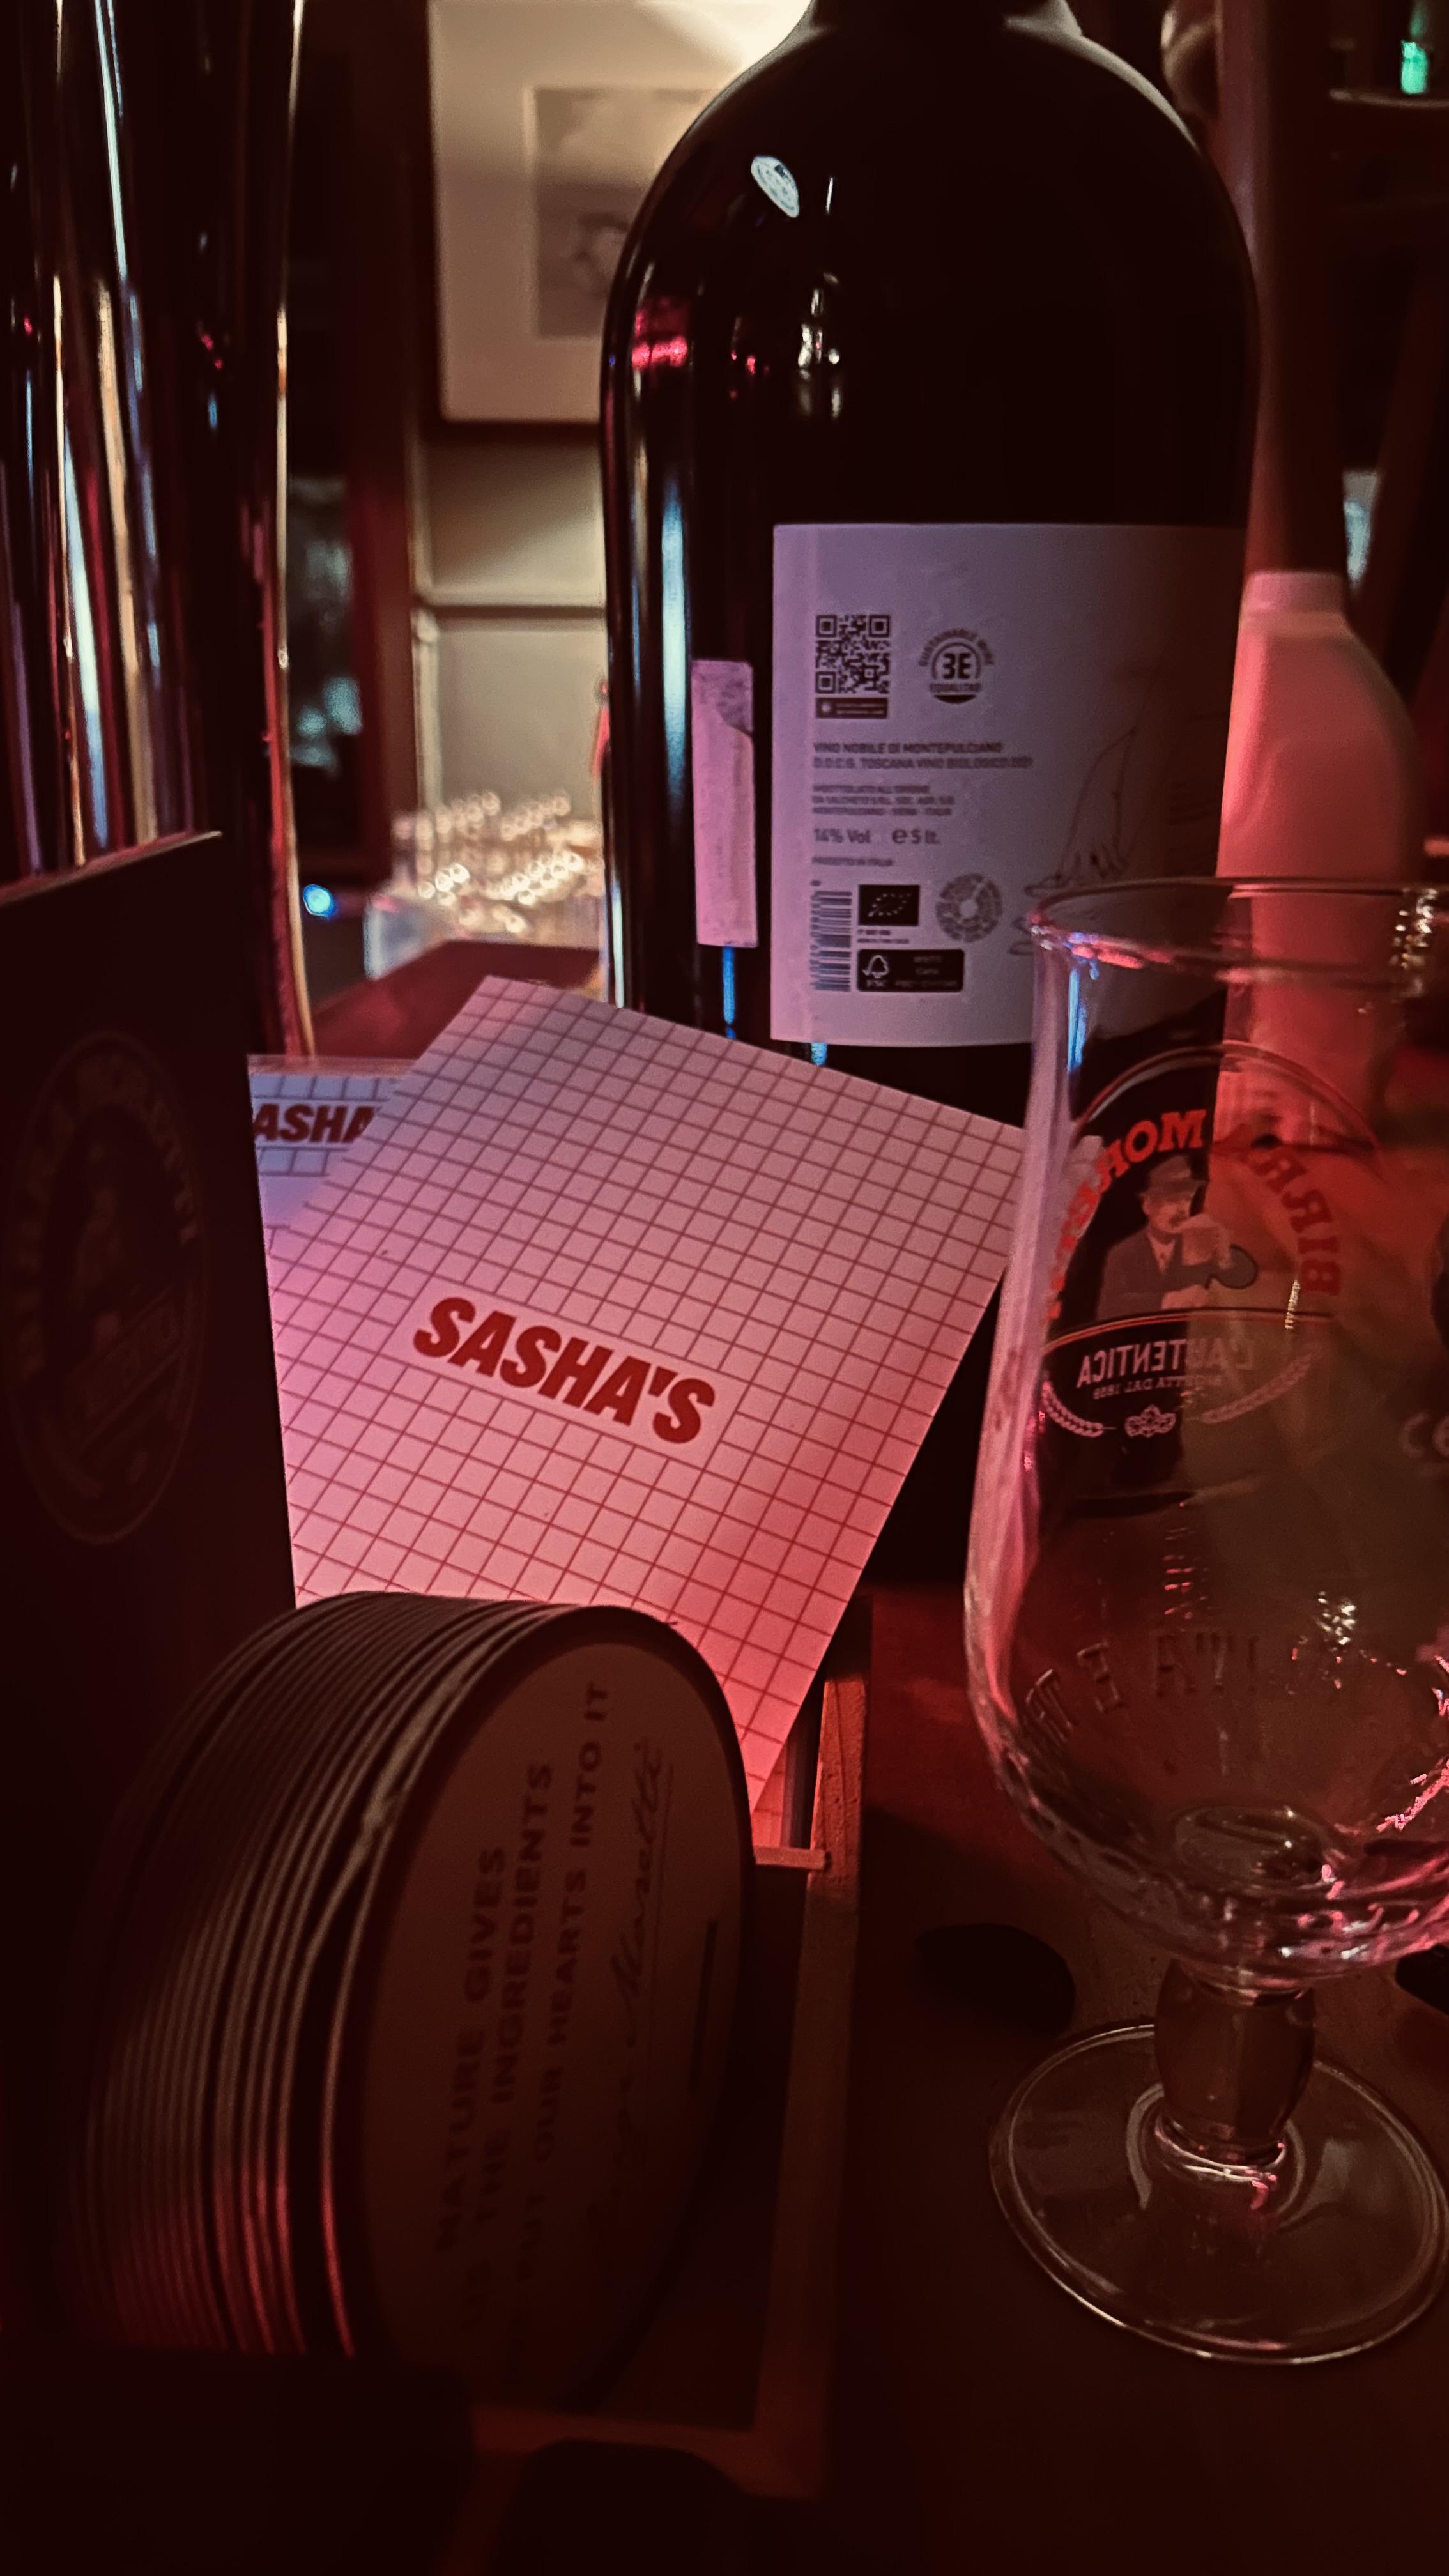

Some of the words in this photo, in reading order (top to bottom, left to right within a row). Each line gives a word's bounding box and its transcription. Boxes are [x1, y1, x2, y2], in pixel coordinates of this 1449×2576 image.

[942, 652, 972, 680] 3E
[813, 742, 841, 753] VINO
[843, 742, 885, 753] NOBILE
[859, 757, 914, 768] TOSCANA
[917, 757, 944, 768] VINO
[814, 828, 844, 843] 14%
[413, 1297, 715, 1444] SASHA'S
[583, 1682, 608, 1722] IT
[569, 1742, 602, 1848] INTO
[490, 1761, 553, 2103] INGREDIENTS
[546, 1868, 586, 2044] HEARTS
[434, 2027, 484, 2252] NATURE
[464, 1845, 506, 2004] GIVES
[532, 2065, 564, 2163] OUR
[475, 2128, 509, 2226] THE
